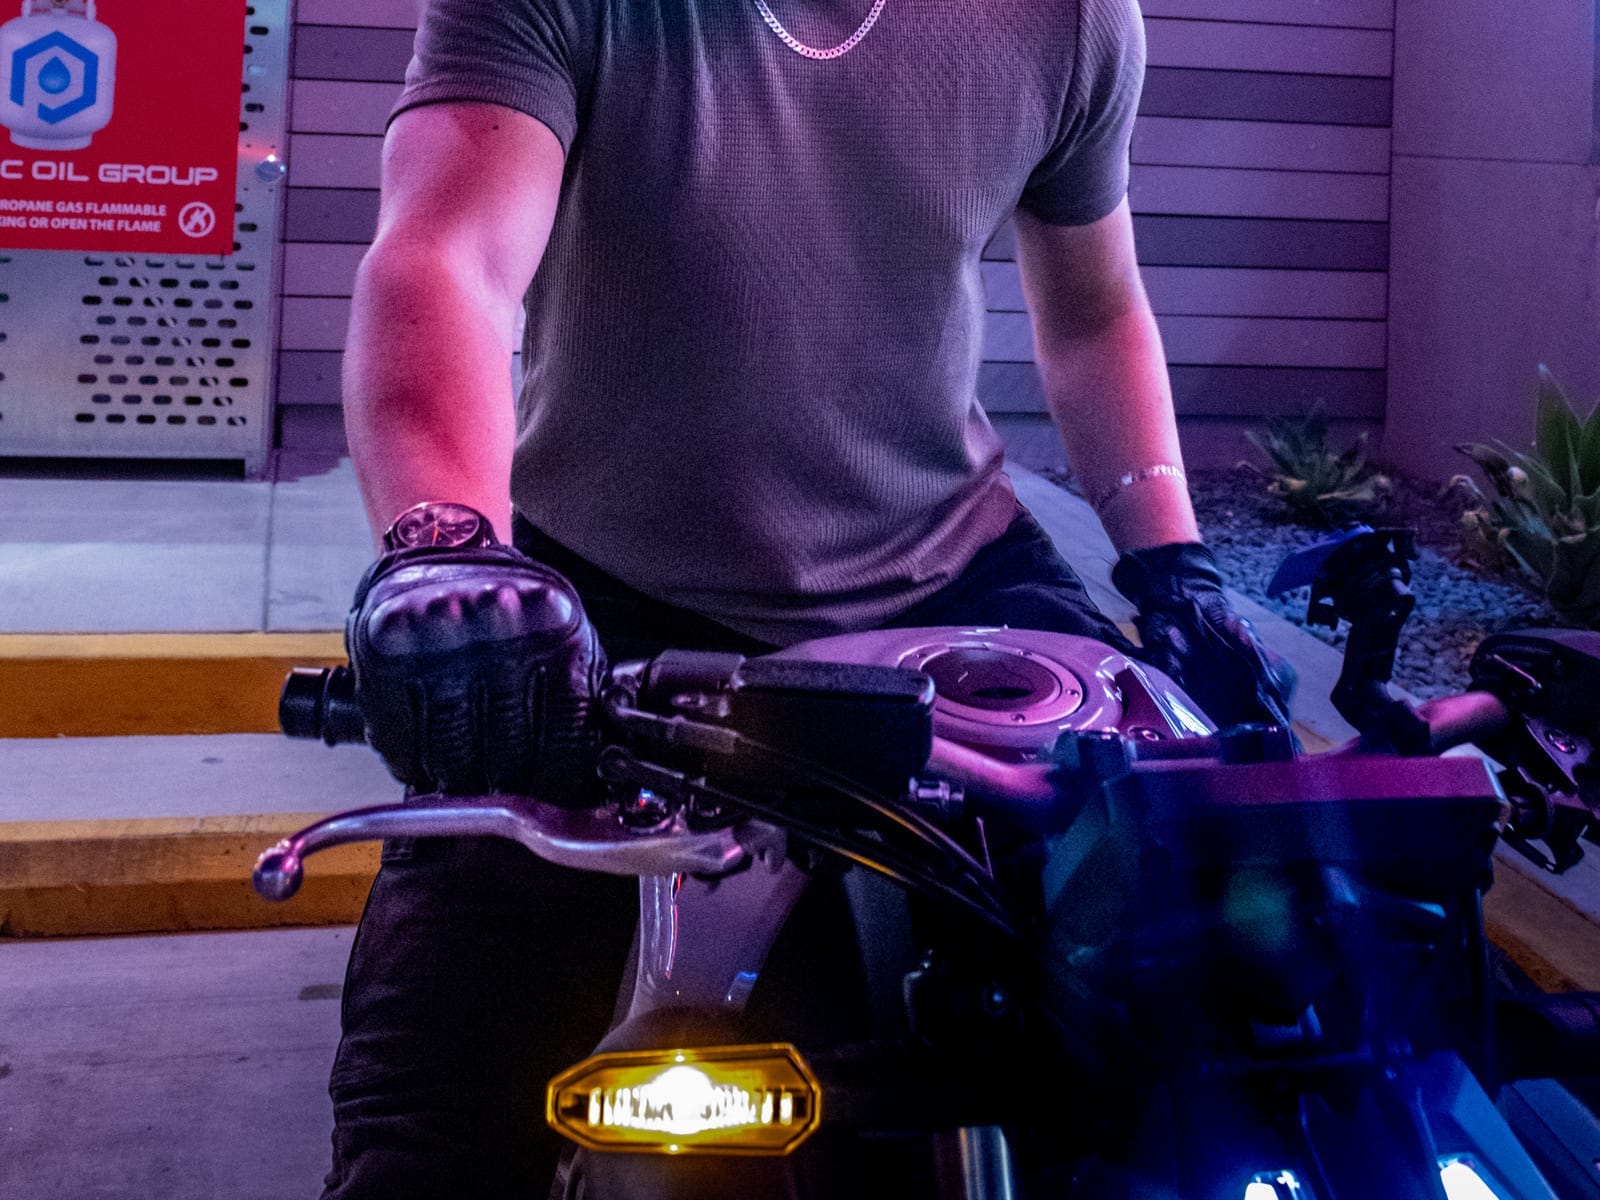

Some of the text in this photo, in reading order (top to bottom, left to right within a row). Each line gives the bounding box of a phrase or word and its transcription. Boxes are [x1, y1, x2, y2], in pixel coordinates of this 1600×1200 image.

[32, 161, 89, 181] OIL
[98, 164, 218, 185] GROUP
[56, 201, 83, 213] GAS
[86, 202, 166, 216] FLAMMABLE
[29, 217, 49, 228] OR
[50, 218, 87, 229] OPEN
[89, 219, 114, 231] THE
[117, 220, 161, 232] FLAME
